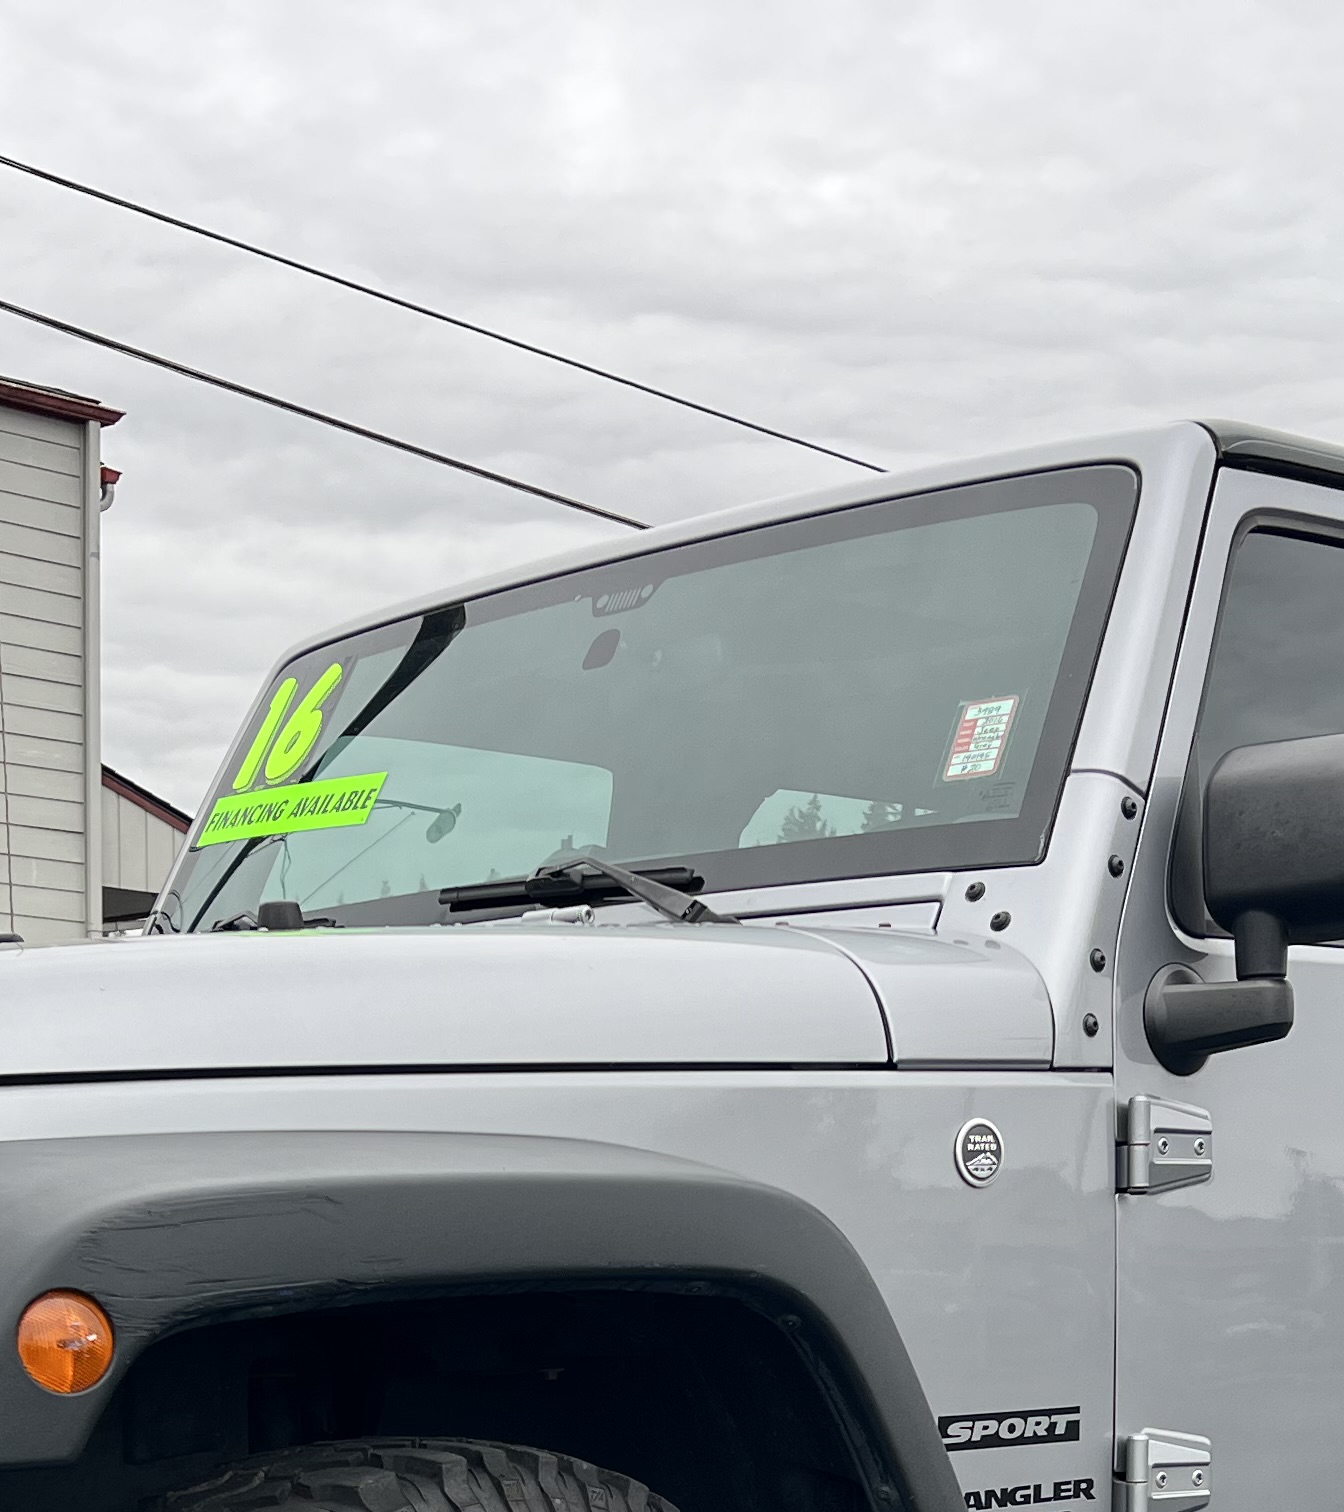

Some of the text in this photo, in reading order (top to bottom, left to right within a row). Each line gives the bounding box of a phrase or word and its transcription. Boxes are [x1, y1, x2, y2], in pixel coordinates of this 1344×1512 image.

[232, 662, 343, 793] 16
[204, 788, 378, 833] FINANCING AVAILABLE
[967, 1134, 995, 1144] TRAIL
[967, 1143, 997, 1152] RATED
[942, 1412, 1081, 1445] SPORT
[963, 1478, 1096, 1511] ANGLER
